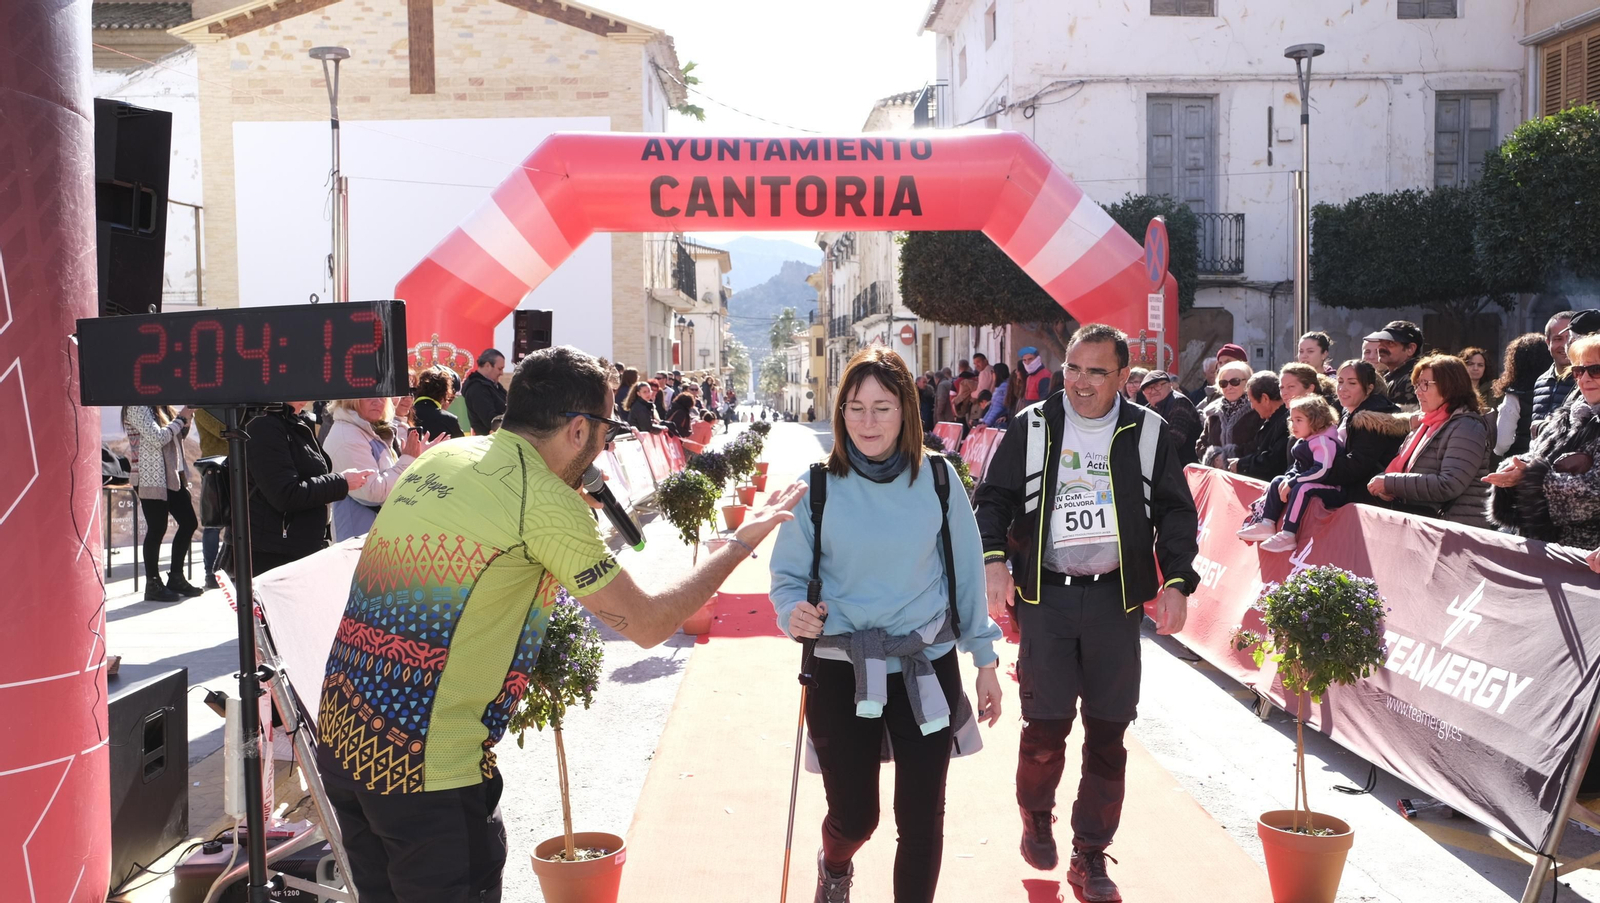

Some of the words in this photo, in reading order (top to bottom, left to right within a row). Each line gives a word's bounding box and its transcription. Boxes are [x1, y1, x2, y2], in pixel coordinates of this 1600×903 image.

[641, 138, 932, 161] AYUNTAMIENTO
[649, 175, 923, 218] CANTORIA
[134, 312, 383, 395] 2:04:12
[1065, 494, 1082, 502] CxM
[1065, 508, 1106, 532] 501
[1382, 630, 1534, 715] TEAMERGY
[1386, 695, 1463, 742] www.teamergy.es
[283, 889, 300, 897] 1200
